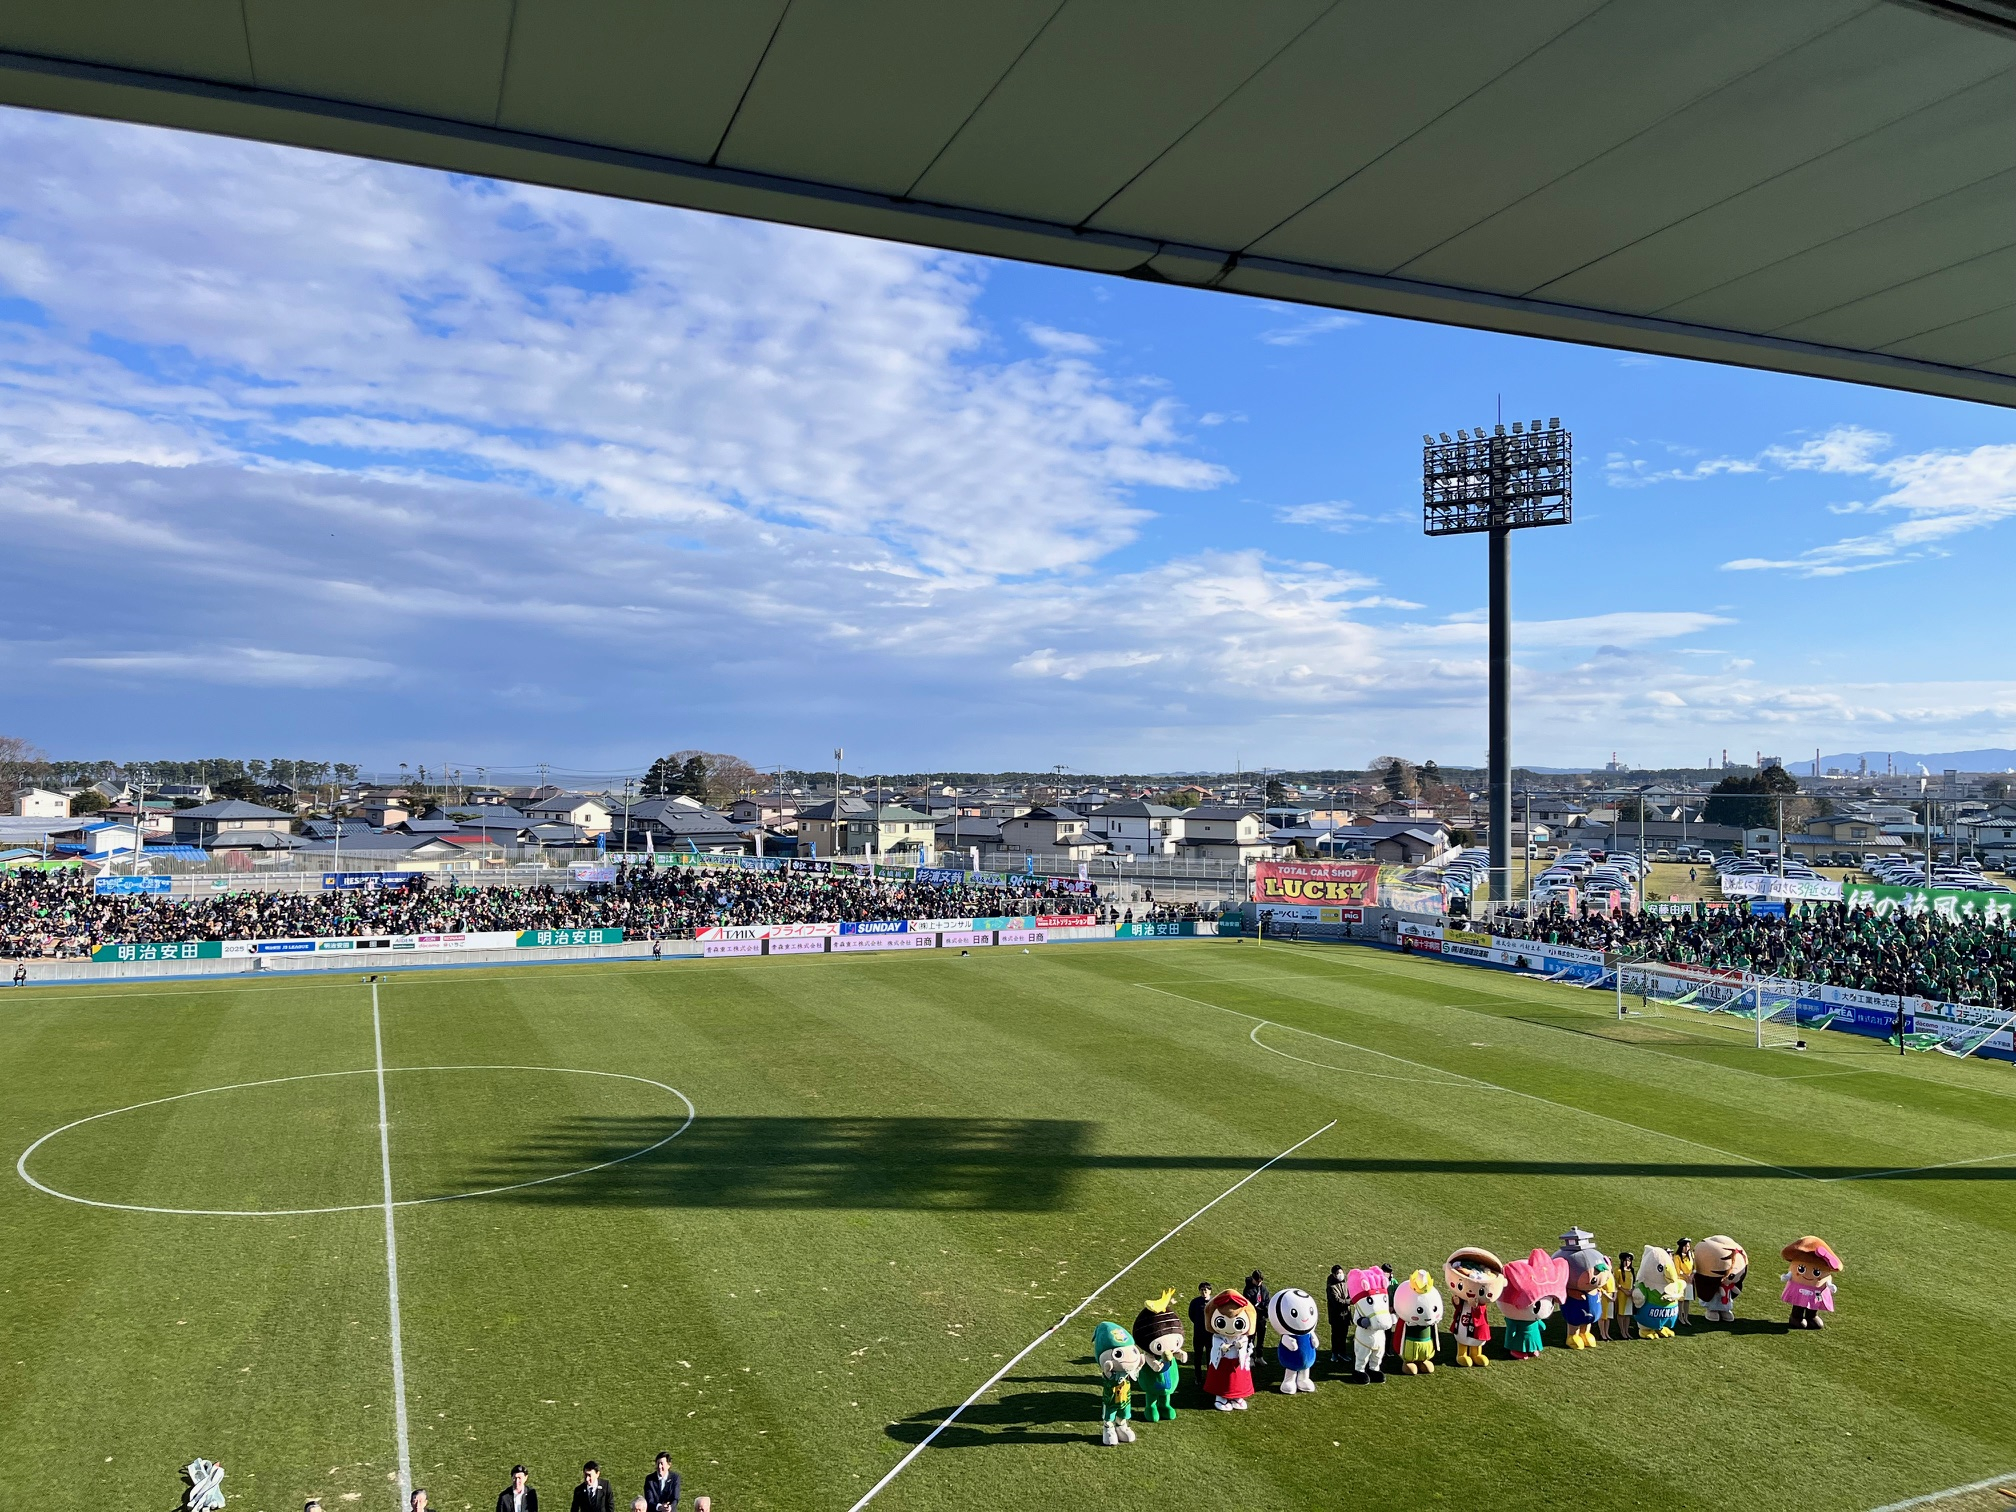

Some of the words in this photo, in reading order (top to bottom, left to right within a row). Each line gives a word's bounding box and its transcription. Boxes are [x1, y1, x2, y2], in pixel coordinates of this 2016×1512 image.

[1278, 865, 1307, 876] TOTAL
[1310, 868, 1329, 877] CAR
[1330, 869, 1358, 879] SHOP
[1264, 877, 1369, 901] LUCKY
[712, 927, 757, 939] ATMIX
[771, 924, 838, 936] プライフーズ
[857, 922, 902, 933] SUNDAY
[1131, 923, 1180, 936] 明治安田
[537, 931, 603, 945] 明治安田
[916, 937, 932, 946] 日商
[973, 935, 989, 944] 日商
[1028, 933, 1044, 942] 日商
[118, 944, 198, 960] 明治安田
[1915, 1020, 1939, 1029] docomo
